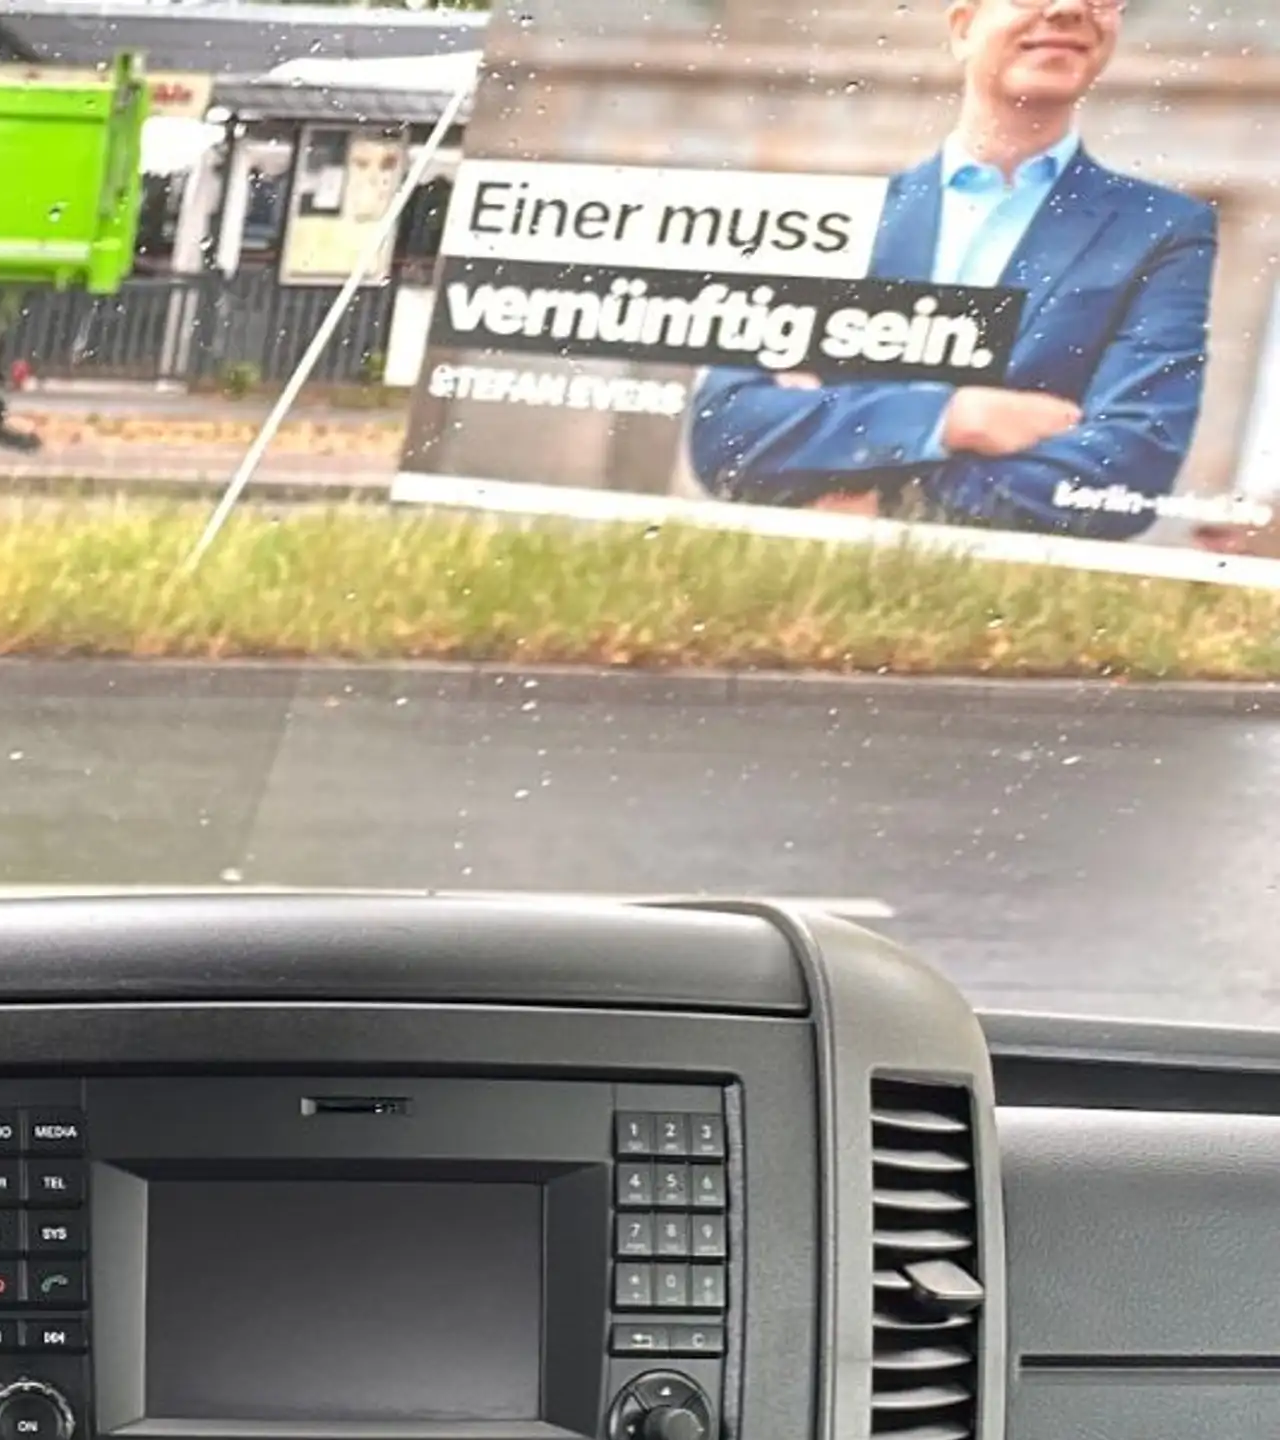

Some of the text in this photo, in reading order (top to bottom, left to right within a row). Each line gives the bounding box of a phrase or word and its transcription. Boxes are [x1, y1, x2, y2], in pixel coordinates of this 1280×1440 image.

[469, 180, 853, 258] Einer muss
[447, 278, 994, 369] vernünftig sein.
[34, 1125, 77, 1139] MEDIA
[630, 1122, 712, 1139] 1 2 3
[43, 1176, 66, 1189] TEL
[629, 1174, 641, 1187] 4
[666, 1174, 677, 1187] 5
[42, 1228, 67, 1240] SYS
[630, 1223, 641, 1237] 7
[18, 1420, 38, 1432] ON
